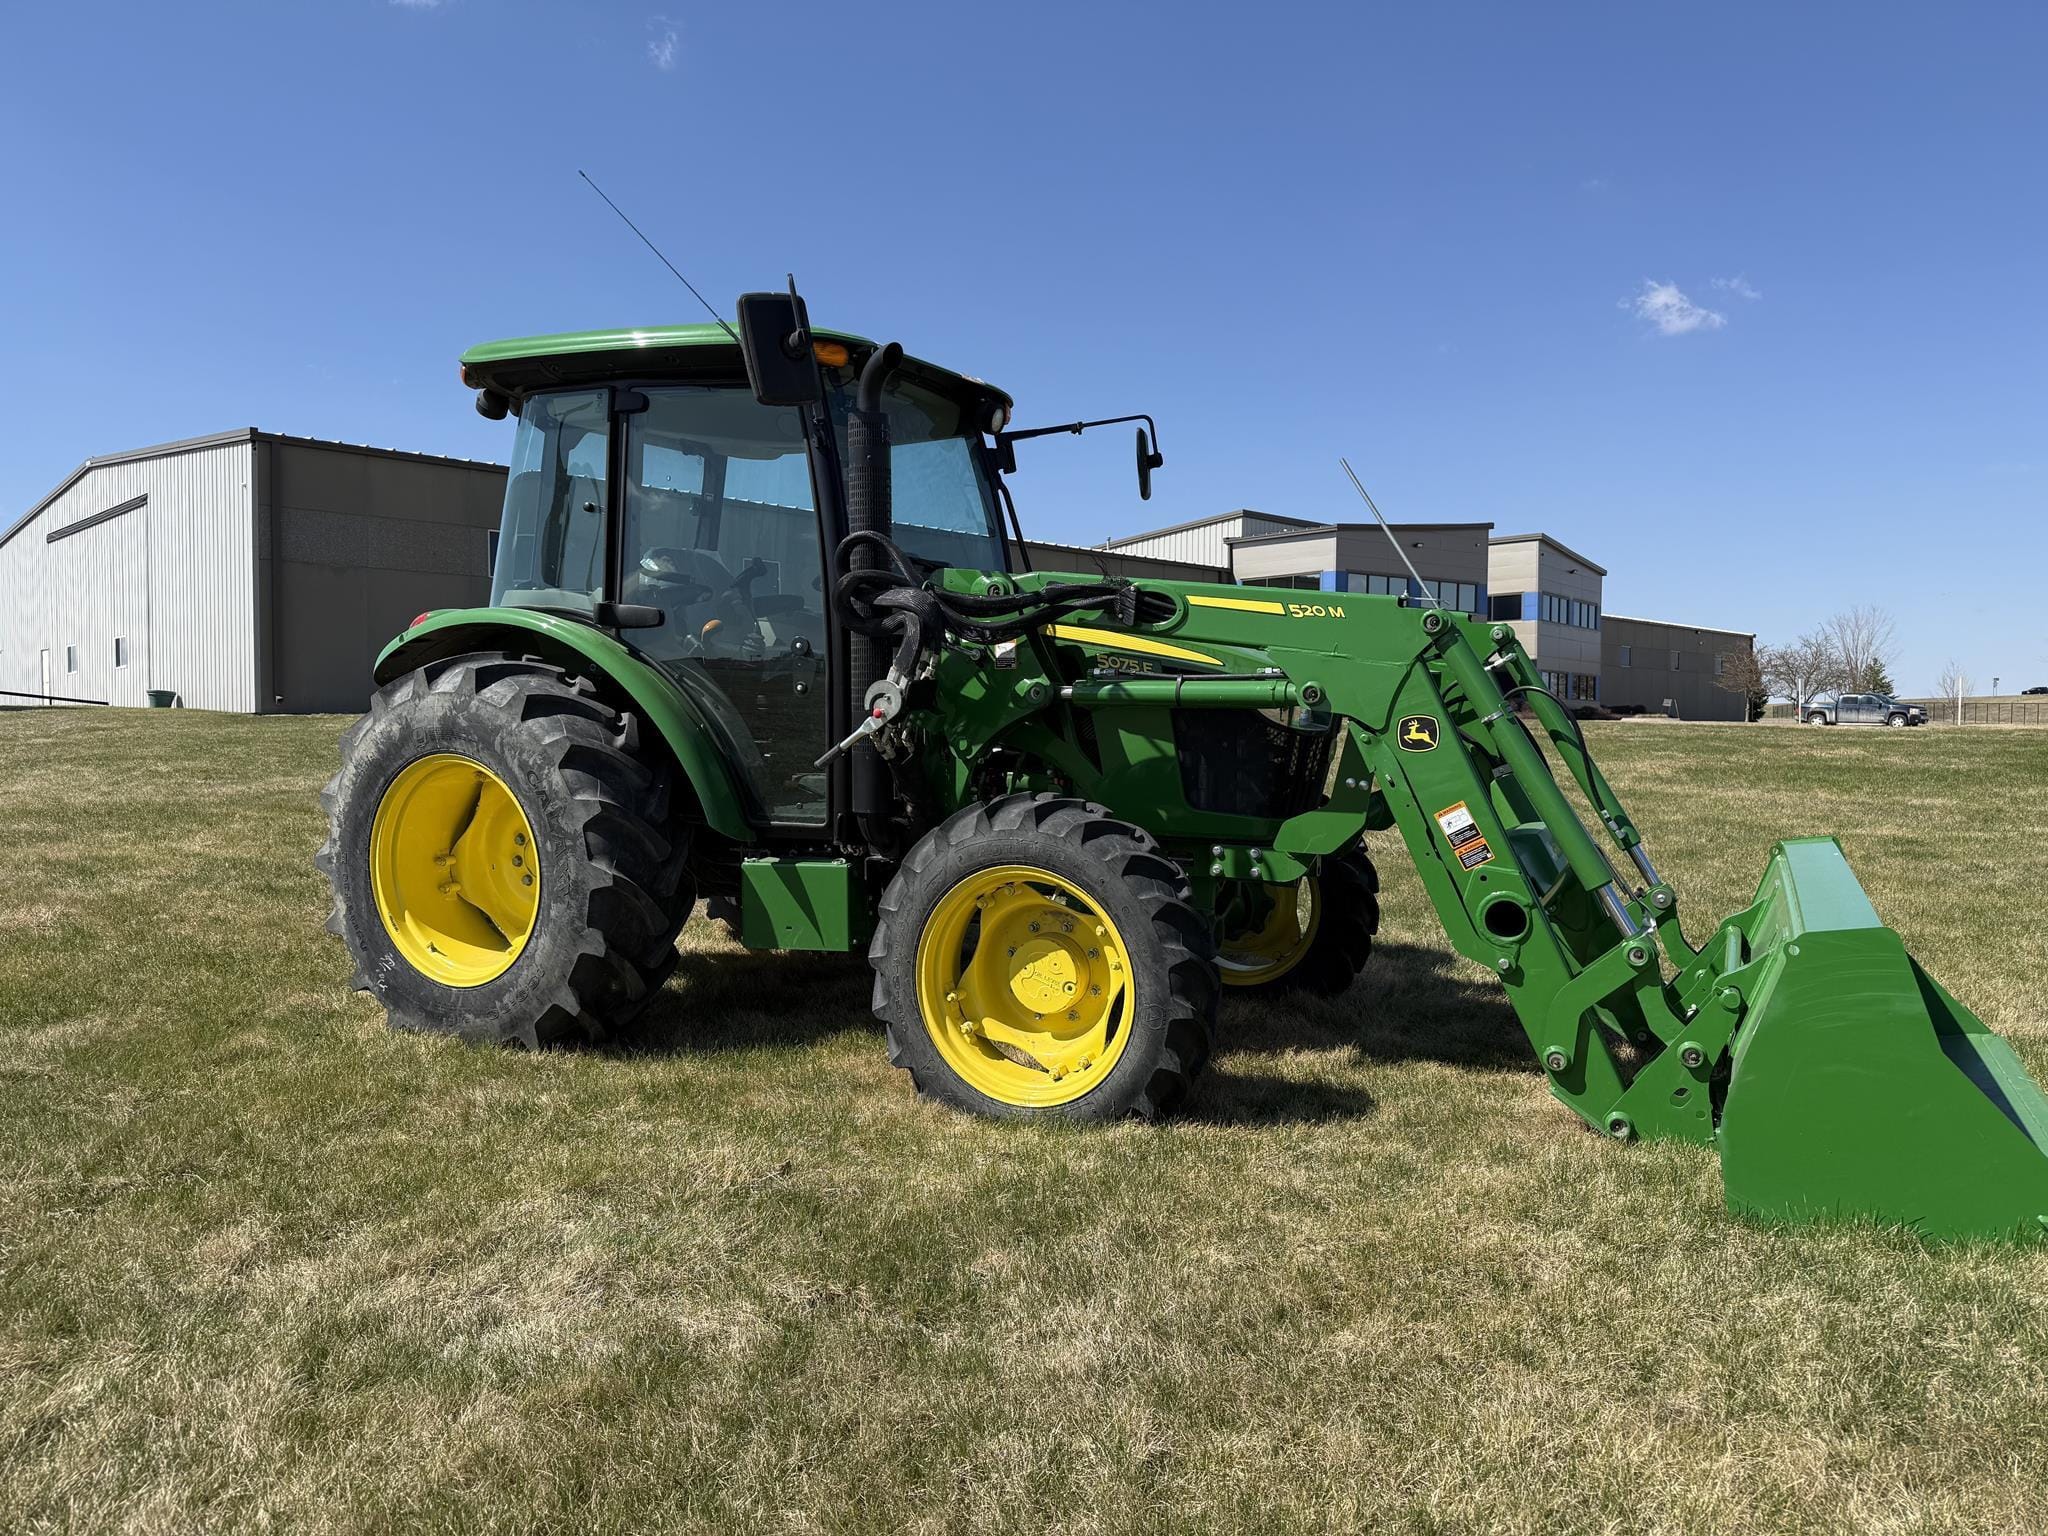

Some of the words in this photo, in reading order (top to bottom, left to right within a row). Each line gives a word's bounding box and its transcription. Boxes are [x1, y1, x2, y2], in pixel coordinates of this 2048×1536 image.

[1287, 603, 1327, 619] 520
[1327, 605, 1346, 619] M
[1096, 653, 1140, 673] 5075
